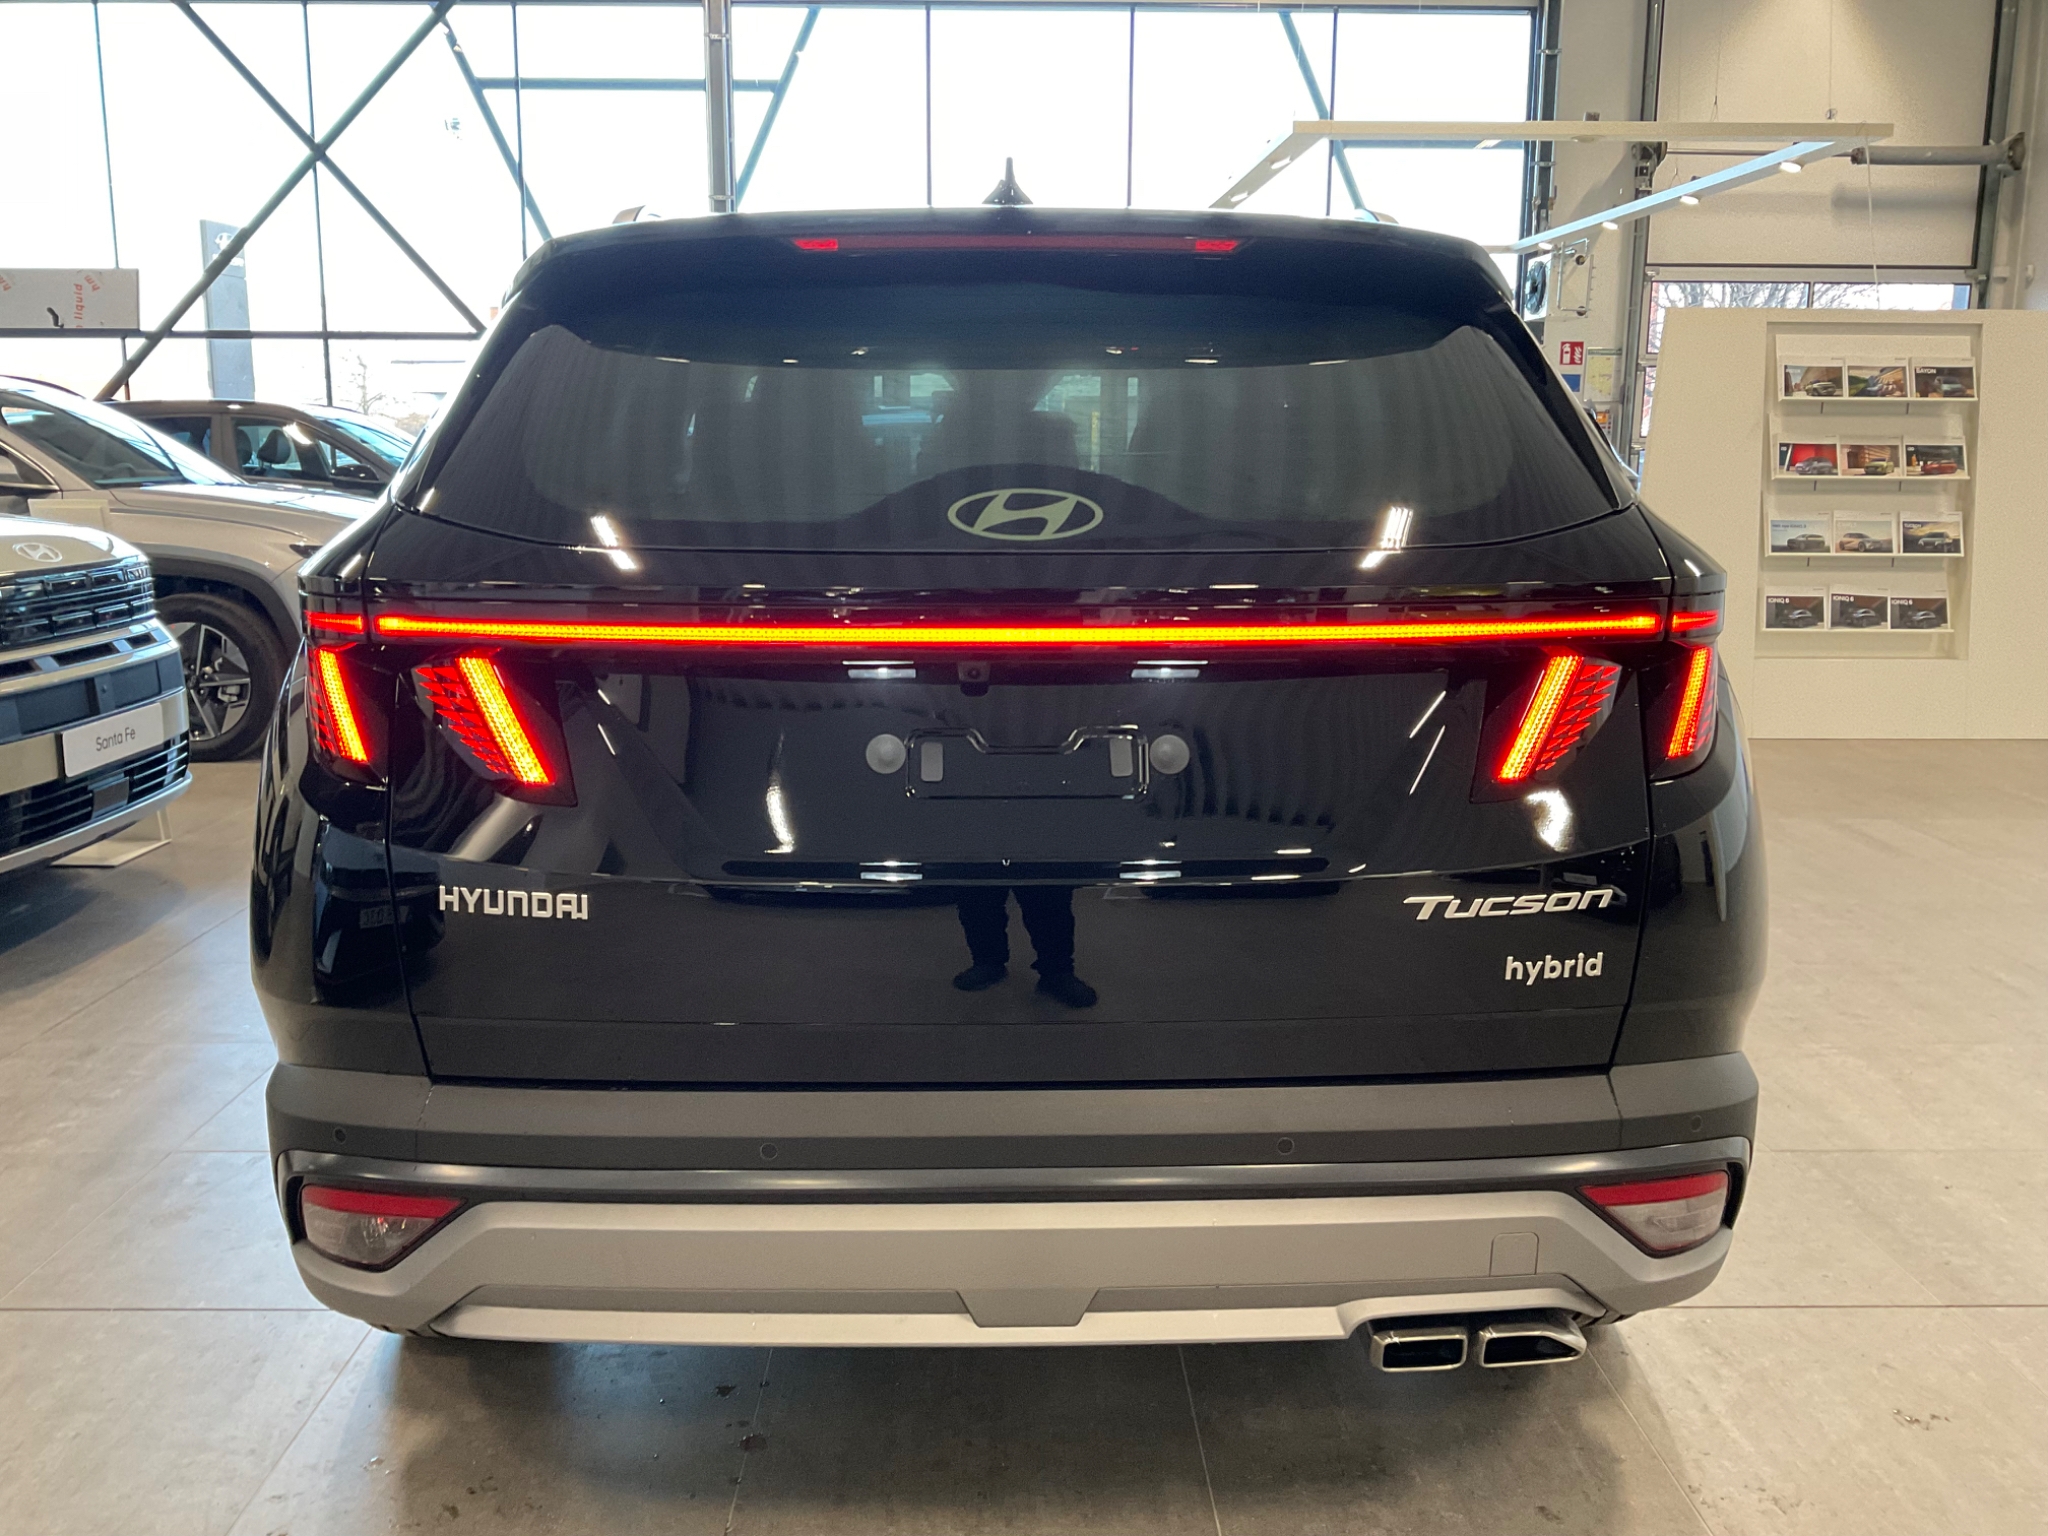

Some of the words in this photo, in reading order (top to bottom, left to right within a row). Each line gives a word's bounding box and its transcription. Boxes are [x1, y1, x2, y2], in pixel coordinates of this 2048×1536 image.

[74, 283, 85, 320] liquid
[95, 733, 123, 751] Santa
[124, 727, 136, 742] Fe
[438, 885, 589, 920] HYUNDAI
[1504, 952, 1604, 986] hybrid
